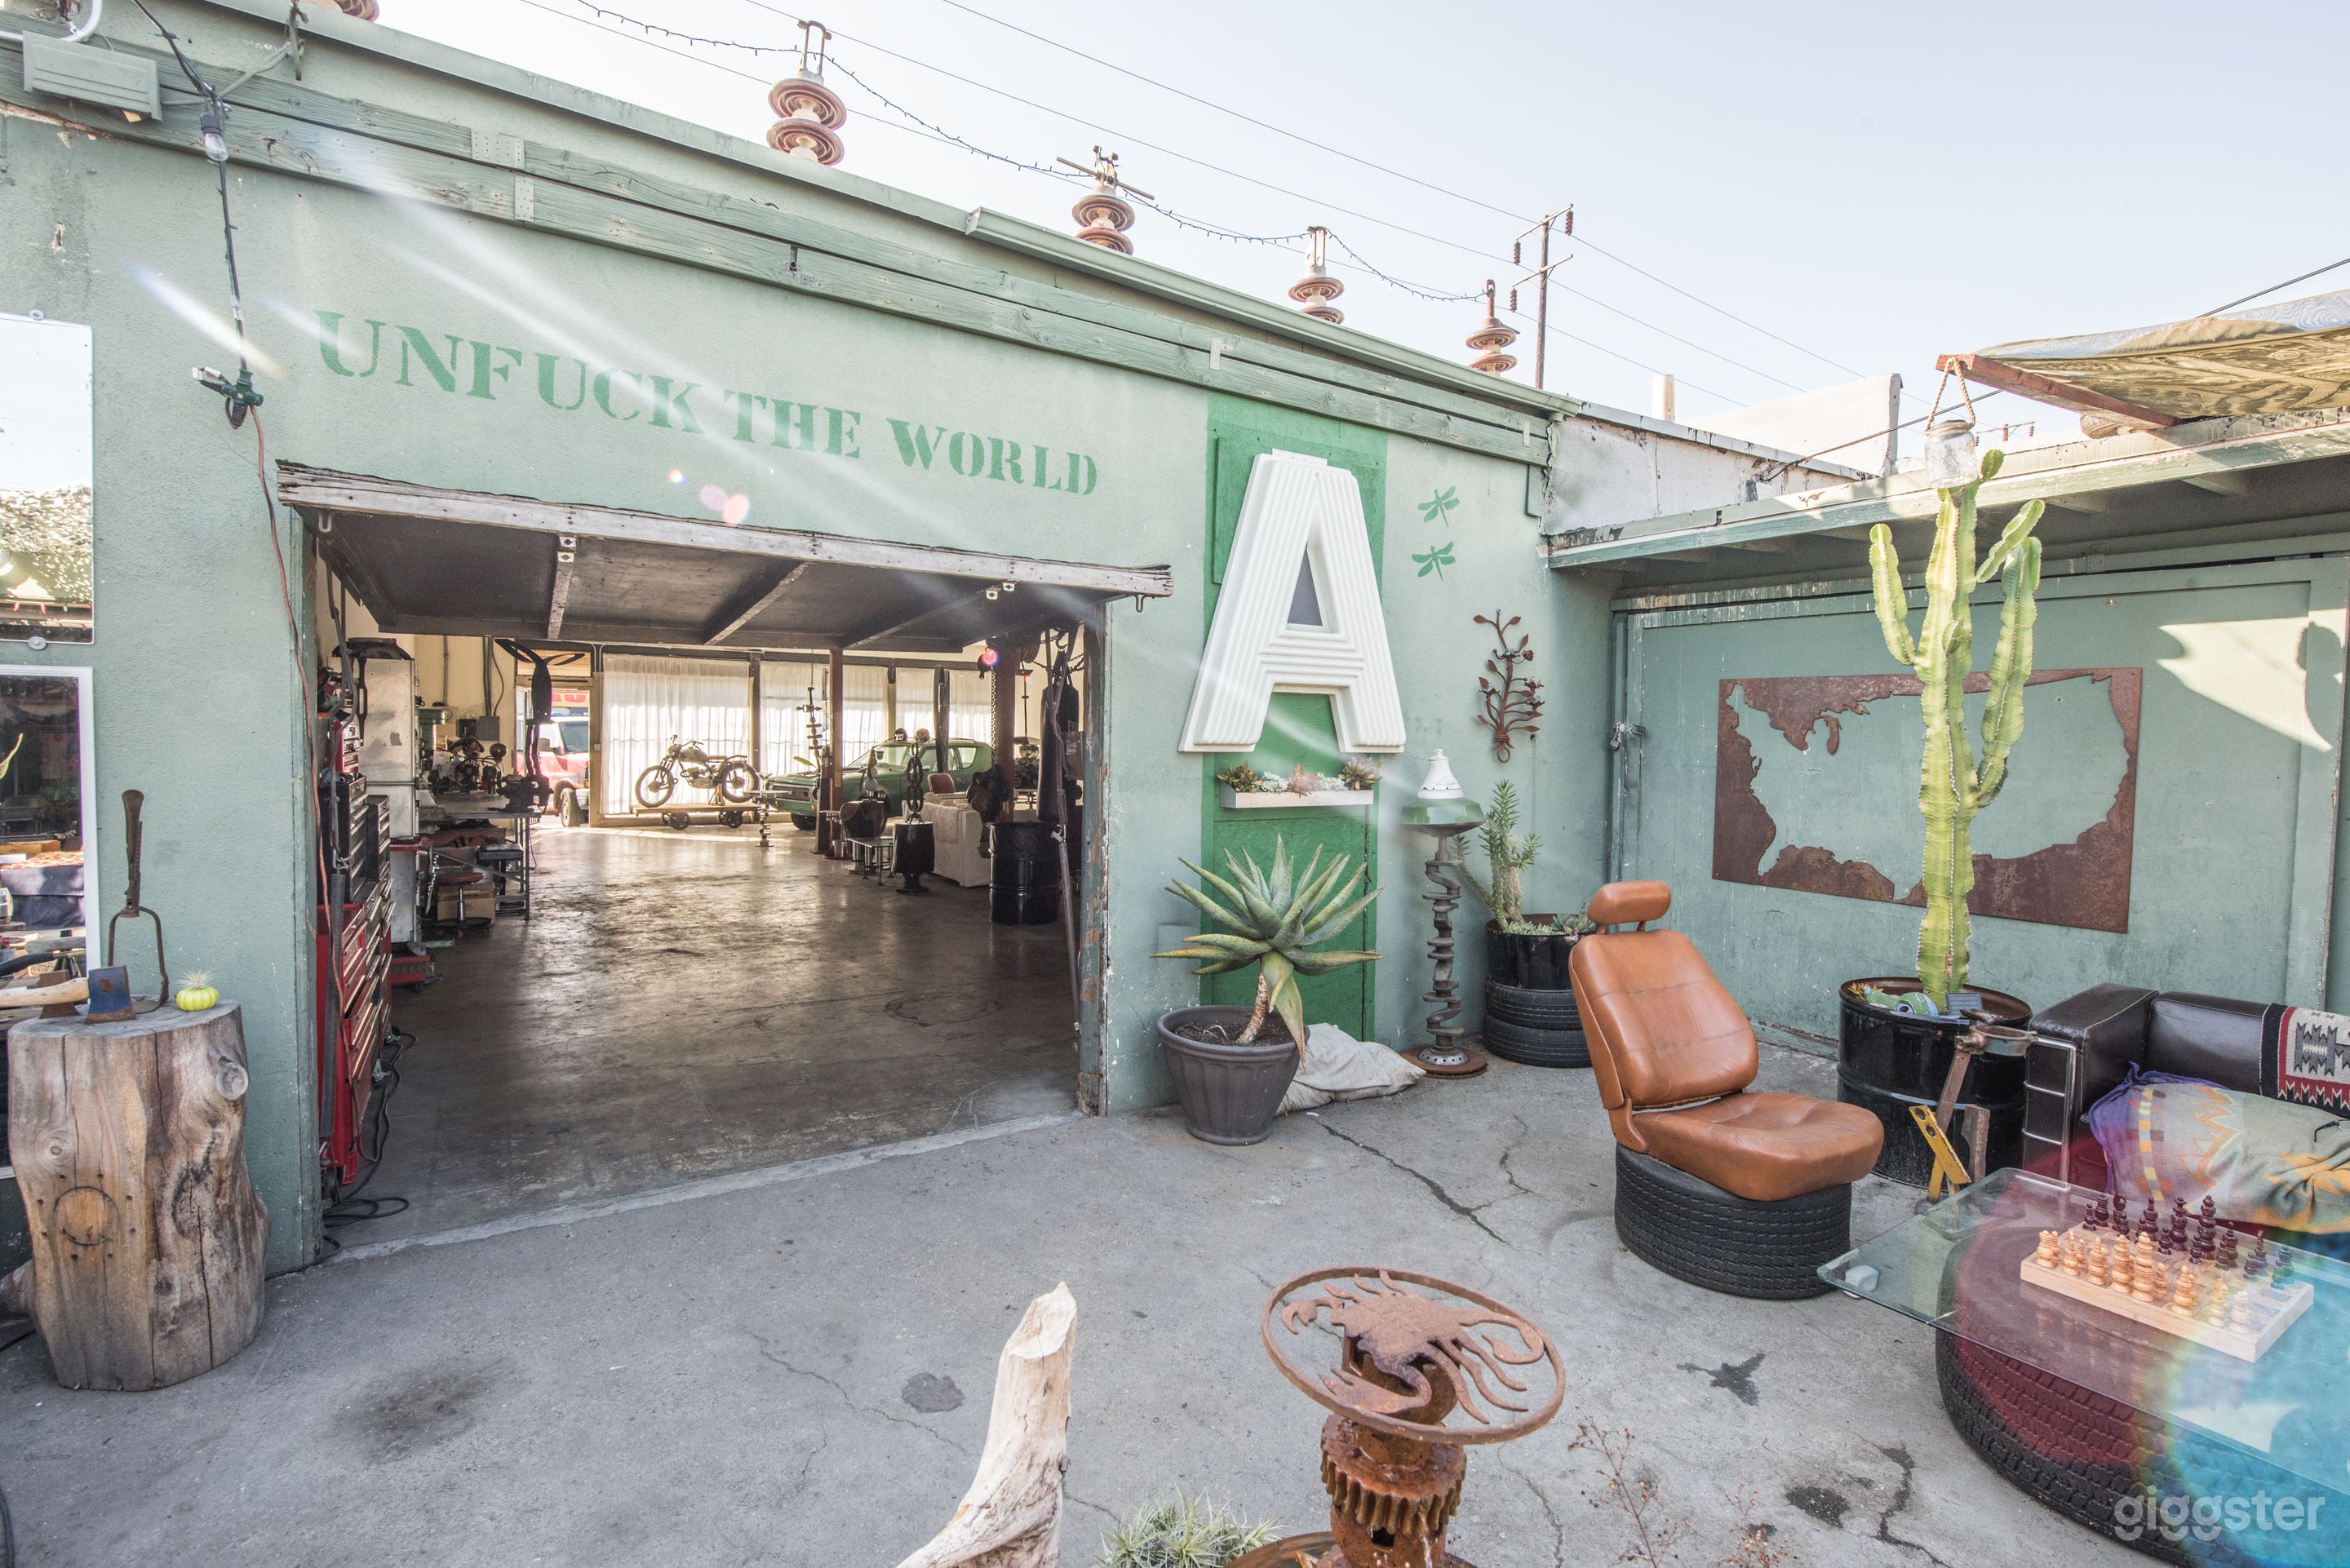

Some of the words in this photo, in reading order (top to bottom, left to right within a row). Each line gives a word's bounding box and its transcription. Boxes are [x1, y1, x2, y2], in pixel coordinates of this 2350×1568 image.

[315, 310, 705, 432] UNFUCK
[724, 391, 861, 458] THE
[886, 419, 1097, 496] WORLD
[1177, 449, 1407, 753] A
